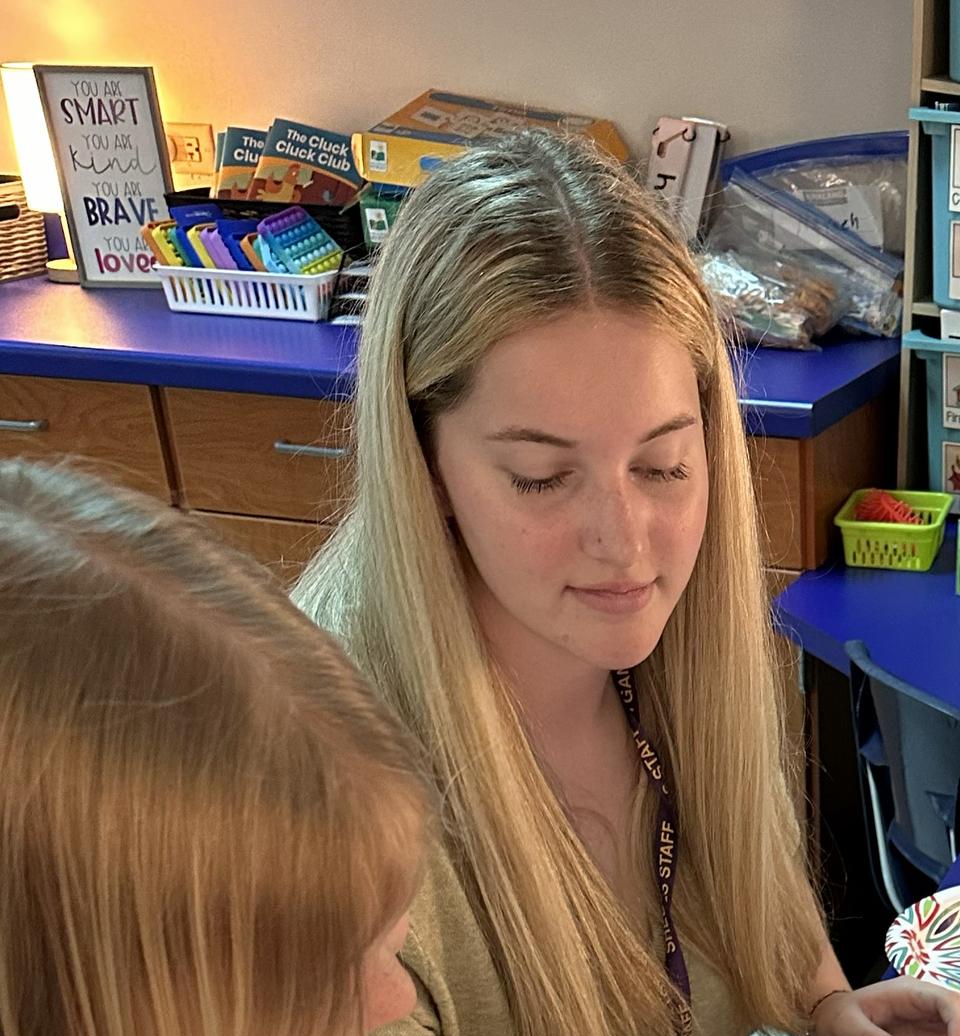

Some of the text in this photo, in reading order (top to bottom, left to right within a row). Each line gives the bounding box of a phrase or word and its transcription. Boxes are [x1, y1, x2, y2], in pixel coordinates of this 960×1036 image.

[71, 80, 121, 97] YOU ARE
[60, 97, 139, 126] SMART
[82, 134, 133, 151] YOU ARE
[242, 136, 265, 149] The
[286, 128, 350, 157] The Cluck
[234, 149, 259, 163] Clu
[276, 140, 316, 162] Cluck
[318, 153, 351, 172] Club
[92, 181, 142, 197] YOU ARE
[83, 196, 159, 226] BRAVE
[103, 236, 130, 252] YOU
[659, 820, 674, 879] STAFF
